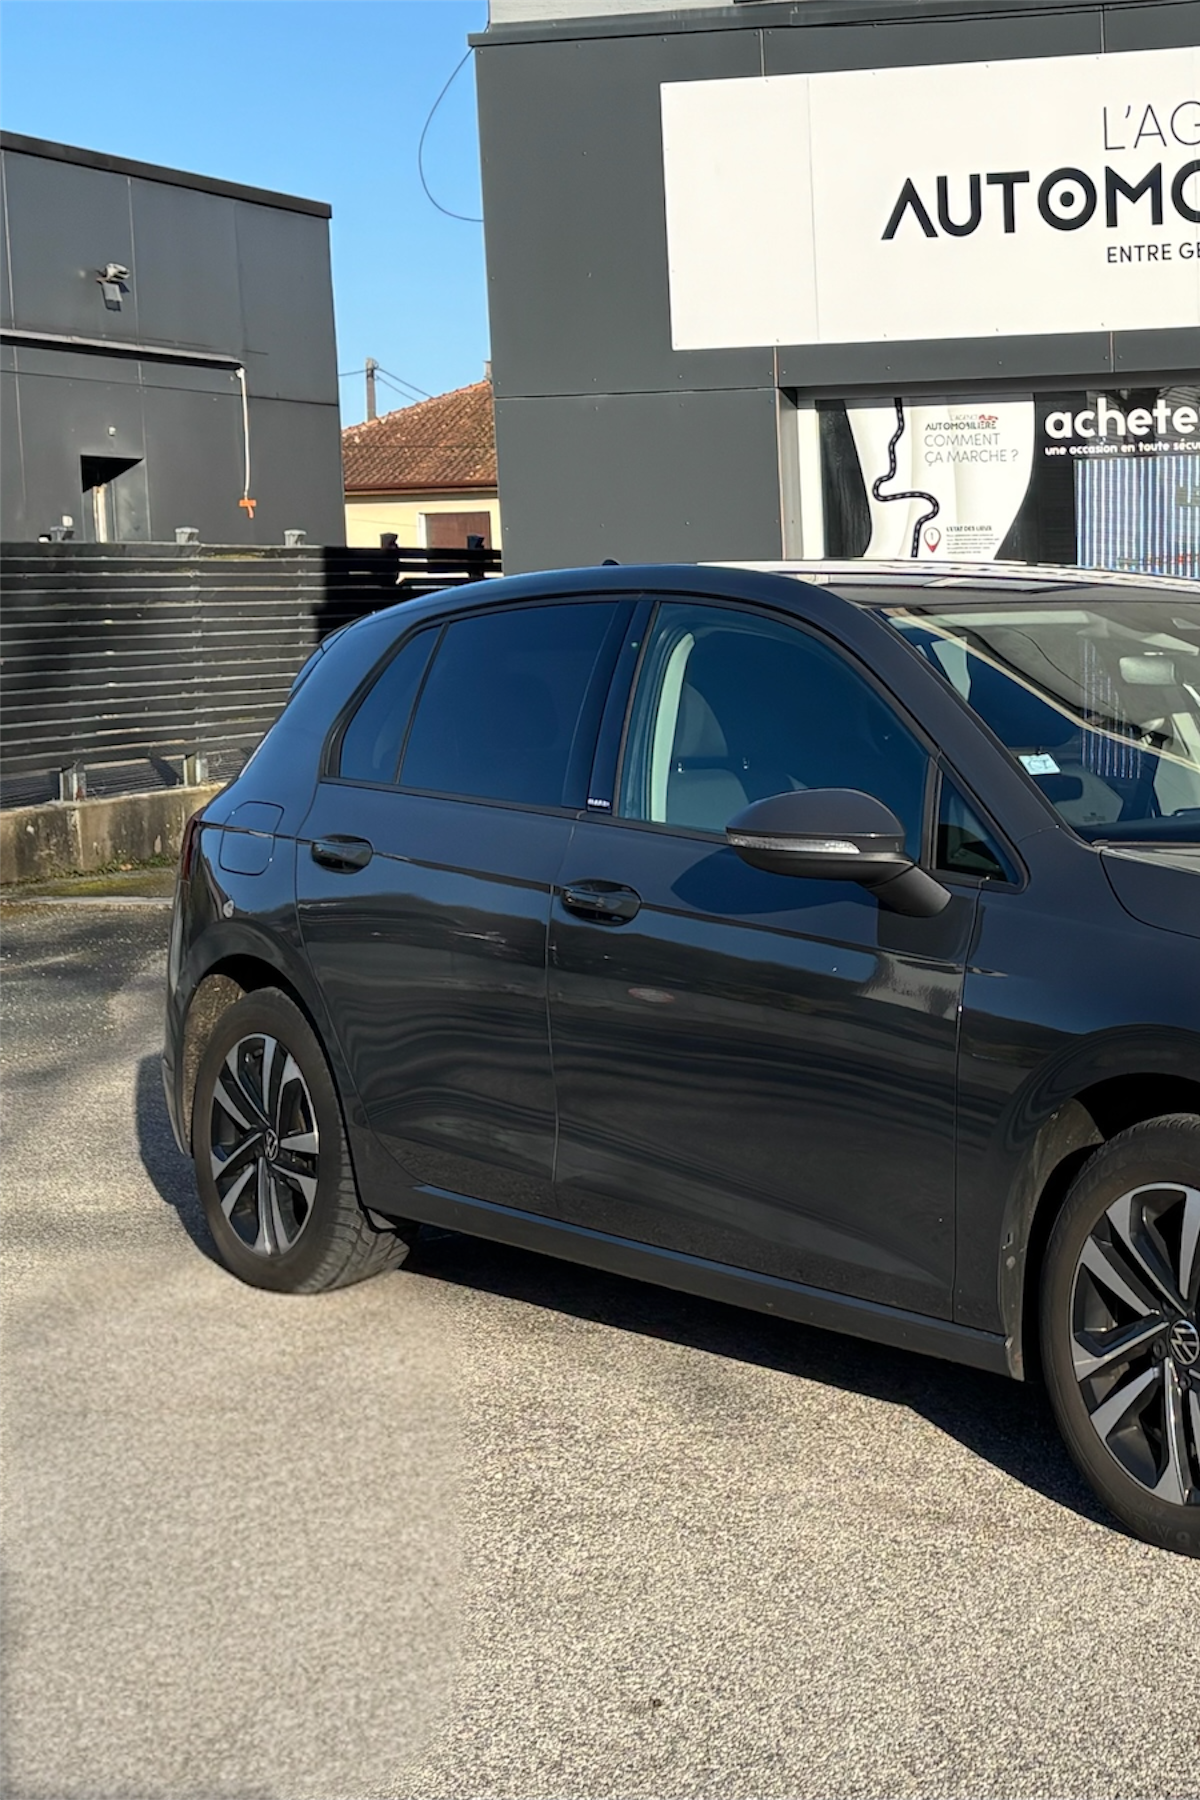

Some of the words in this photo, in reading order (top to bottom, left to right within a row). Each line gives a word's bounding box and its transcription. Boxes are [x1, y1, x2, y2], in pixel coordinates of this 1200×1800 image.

[1106, 243, 1173, 264] ENTRE
[924, 432, 1001, 448] COMMENT
[1044, 445, 1068, 457] une
[1069, 442, 1119, 455] occasion
[1120, 442, 1136, 453] en
[1138, 440, 1170, 452] toute
[924, 450, 944, 467] ÇA
[947, 449, 1007, 463] MARCHE
[1011, 448, 1020, 463] ?
